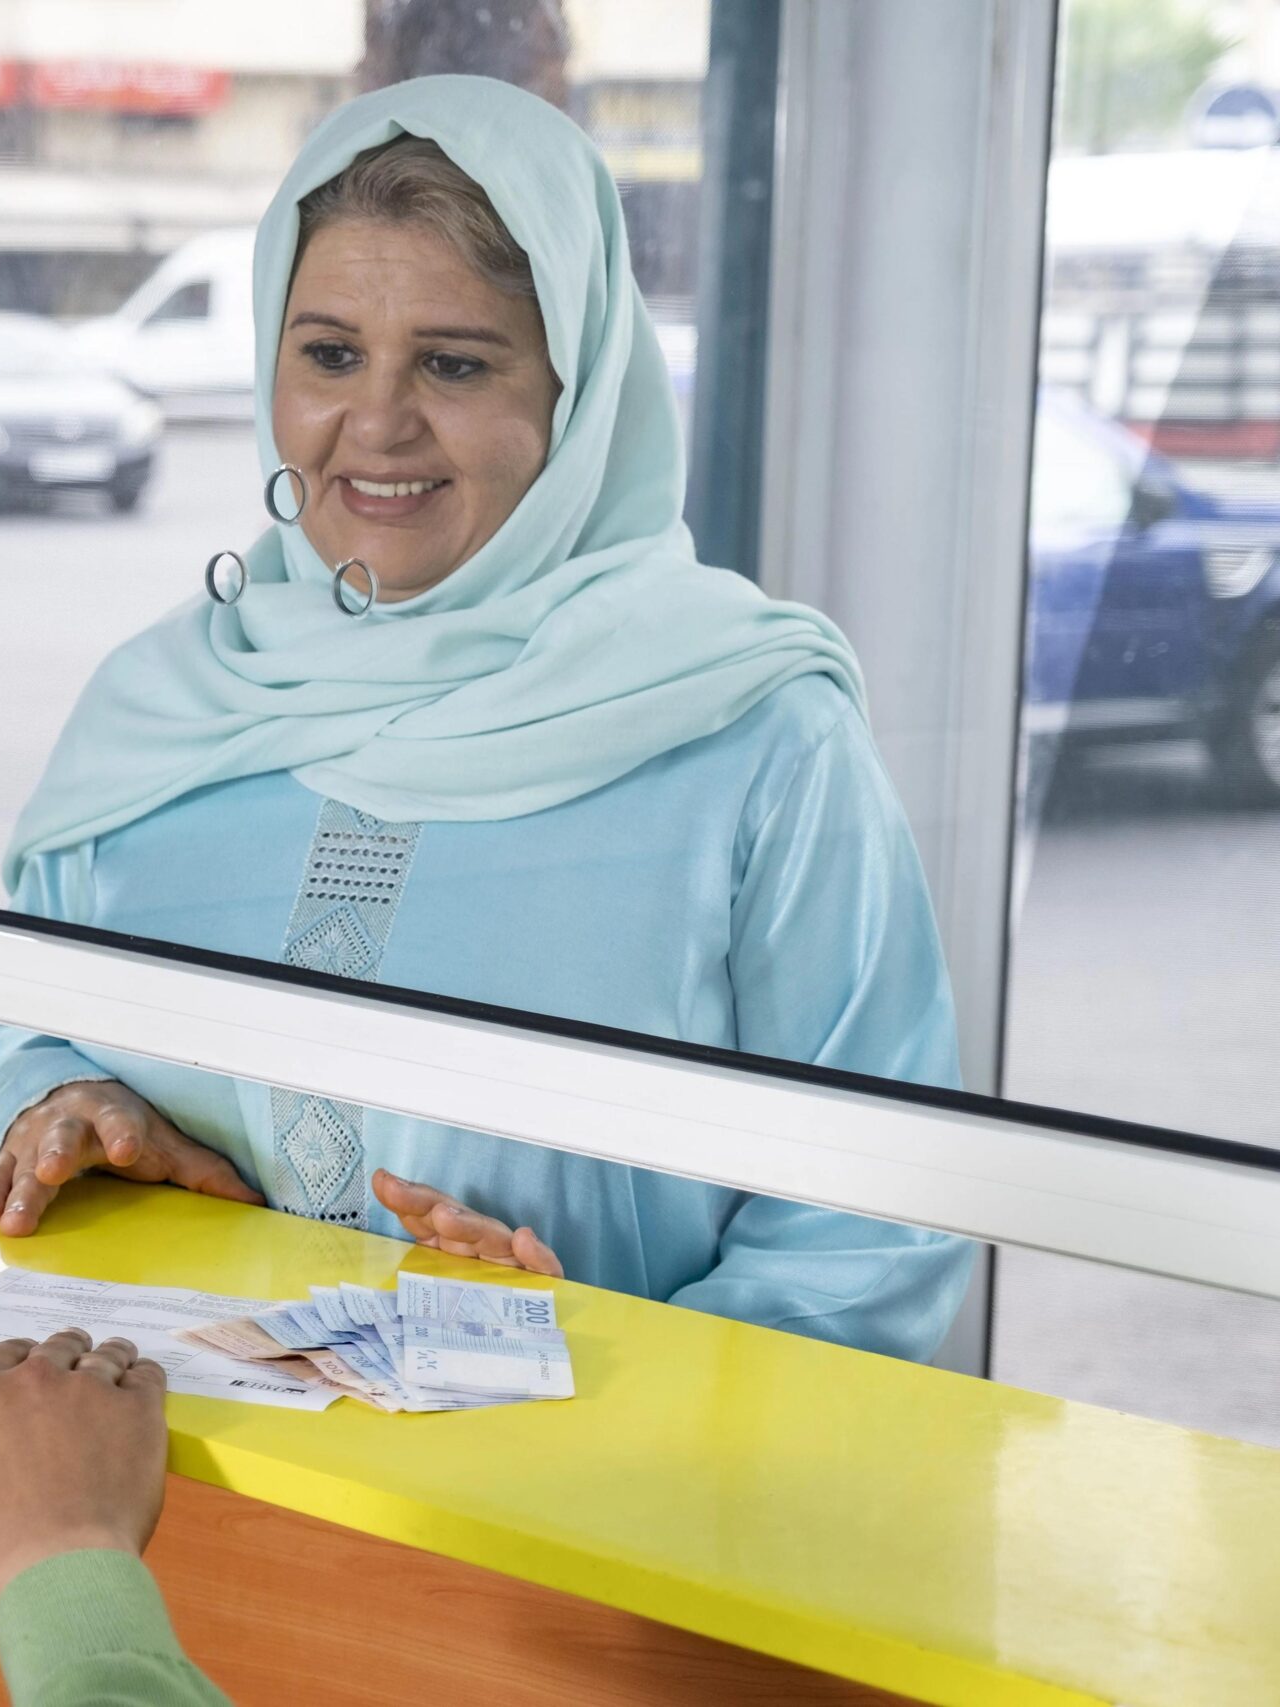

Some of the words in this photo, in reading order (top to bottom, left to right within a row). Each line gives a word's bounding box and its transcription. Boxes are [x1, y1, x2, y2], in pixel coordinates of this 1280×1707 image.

[525, 1299, 550, 1324] 200
[322, 1360, 344, 1376] 100
[351, 1355, 373, 1369] 200
